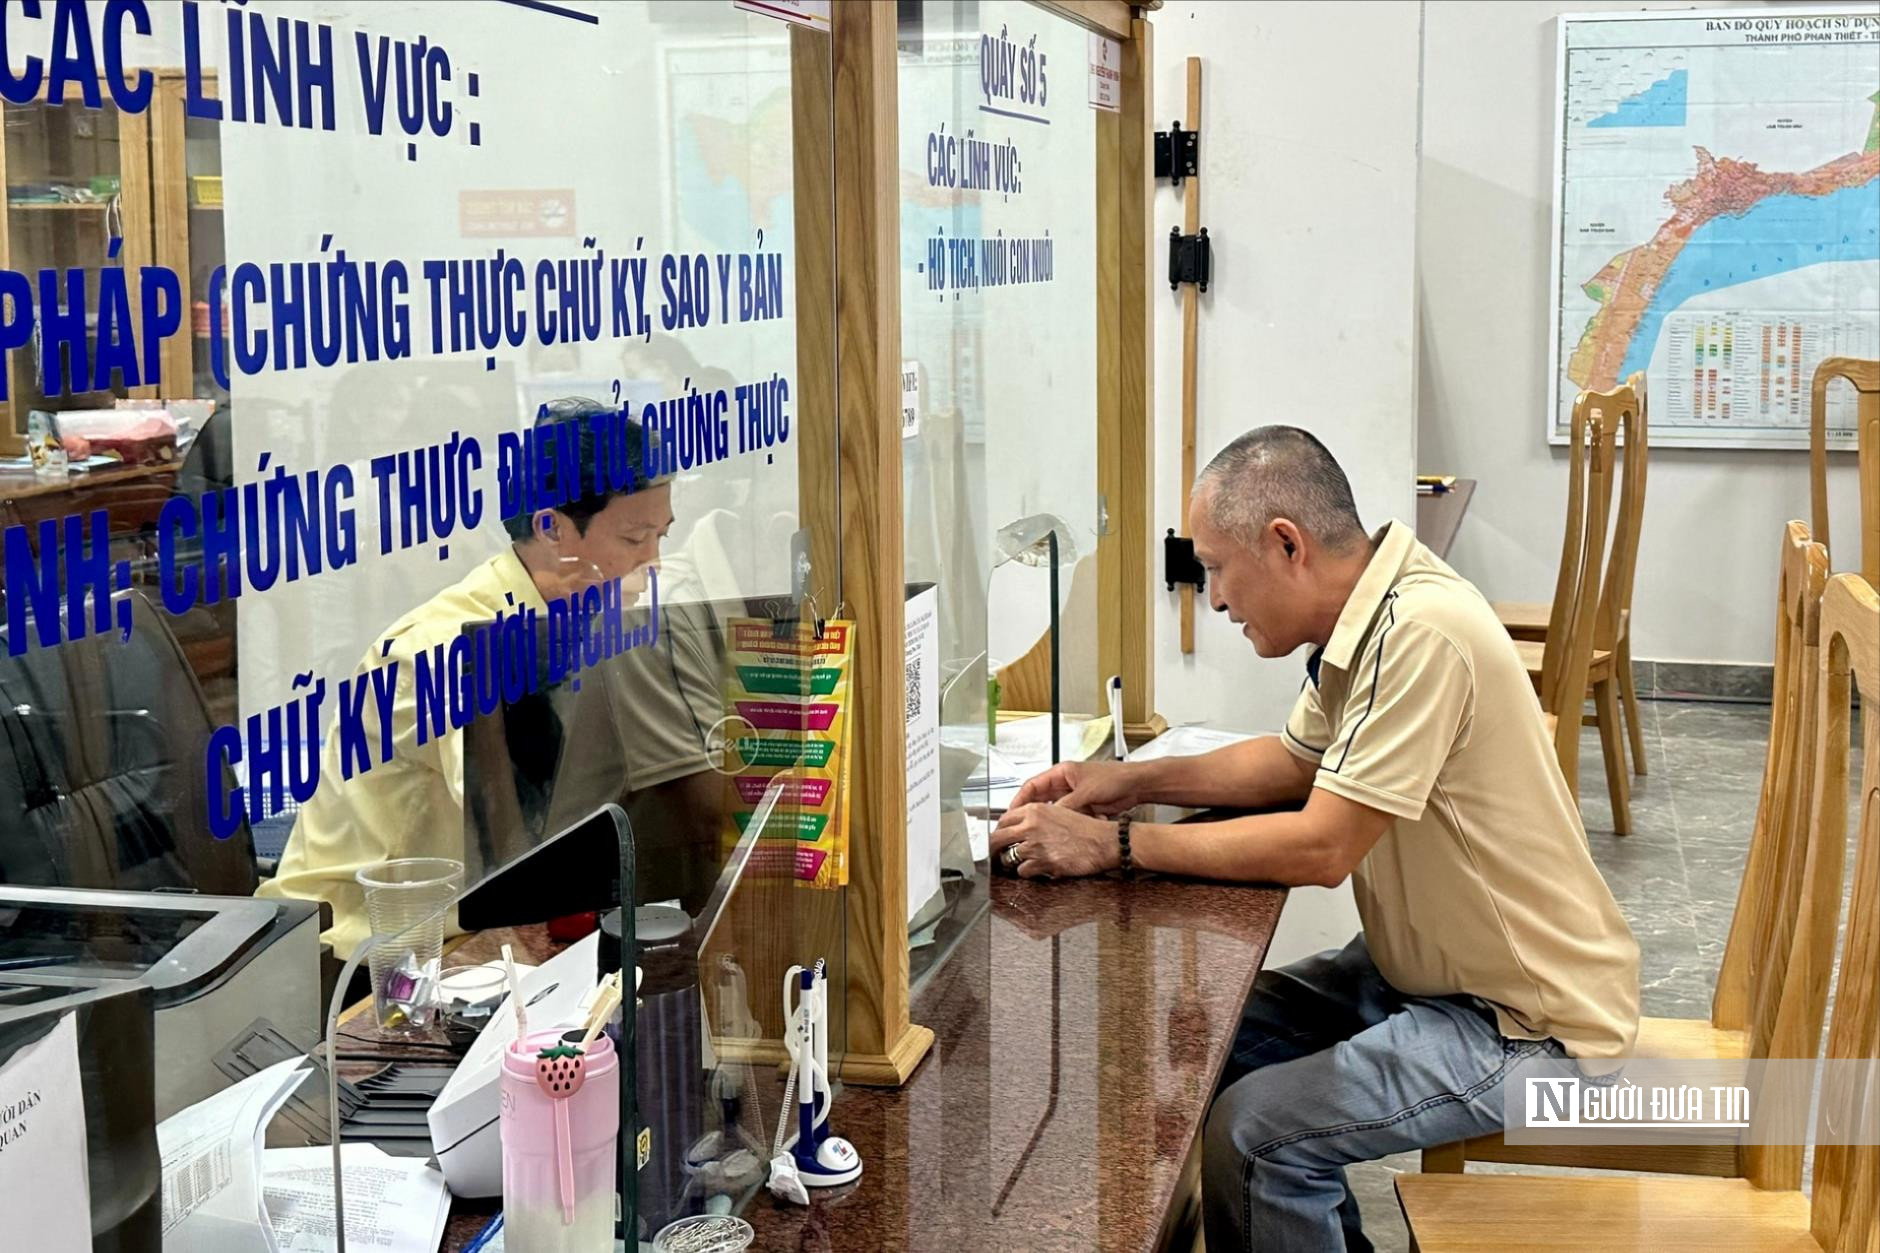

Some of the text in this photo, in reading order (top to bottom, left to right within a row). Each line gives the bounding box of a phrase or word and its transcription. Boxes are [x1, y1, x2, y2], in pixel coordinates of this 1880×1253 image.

[183, 0, 336, 131] LĨNH
[981, 23, 1047, 107] QUẦY SỐ 5
[1804, 32, 1832, 41] PHAN
[927, 122, 956, 188] CÁC
[960, 129, 990, 190] LĨNH
[928, 226, 945, 303] HỘ
[948, 239, 979, 301] TỊCH,
[981, 229, 1007, 287] NUÔI
[1009, 239, 1030, 285] CON
[1031, 229, 1053, 283] NUÔI
[0, 228, 783, 398] PHÁP (CHỨNG THỰC CHỮ KÝ, SAO Y BẢN
[158, 452, 357, 617] CHỨNG
[371, 431, 483, 562] THỰC
[497, 403, 582, 532] ĐIỆN
[642, 377, 729, 480] CHỨNG
[735, 372, 789, 465] THỰC
[207, 670, 326, 840] CHỮ
[339, 638, 400, 782] KÝ
[415, 591, 539, 747] NGƯỜI
[18, 1090, 41, 1115] DÂN
